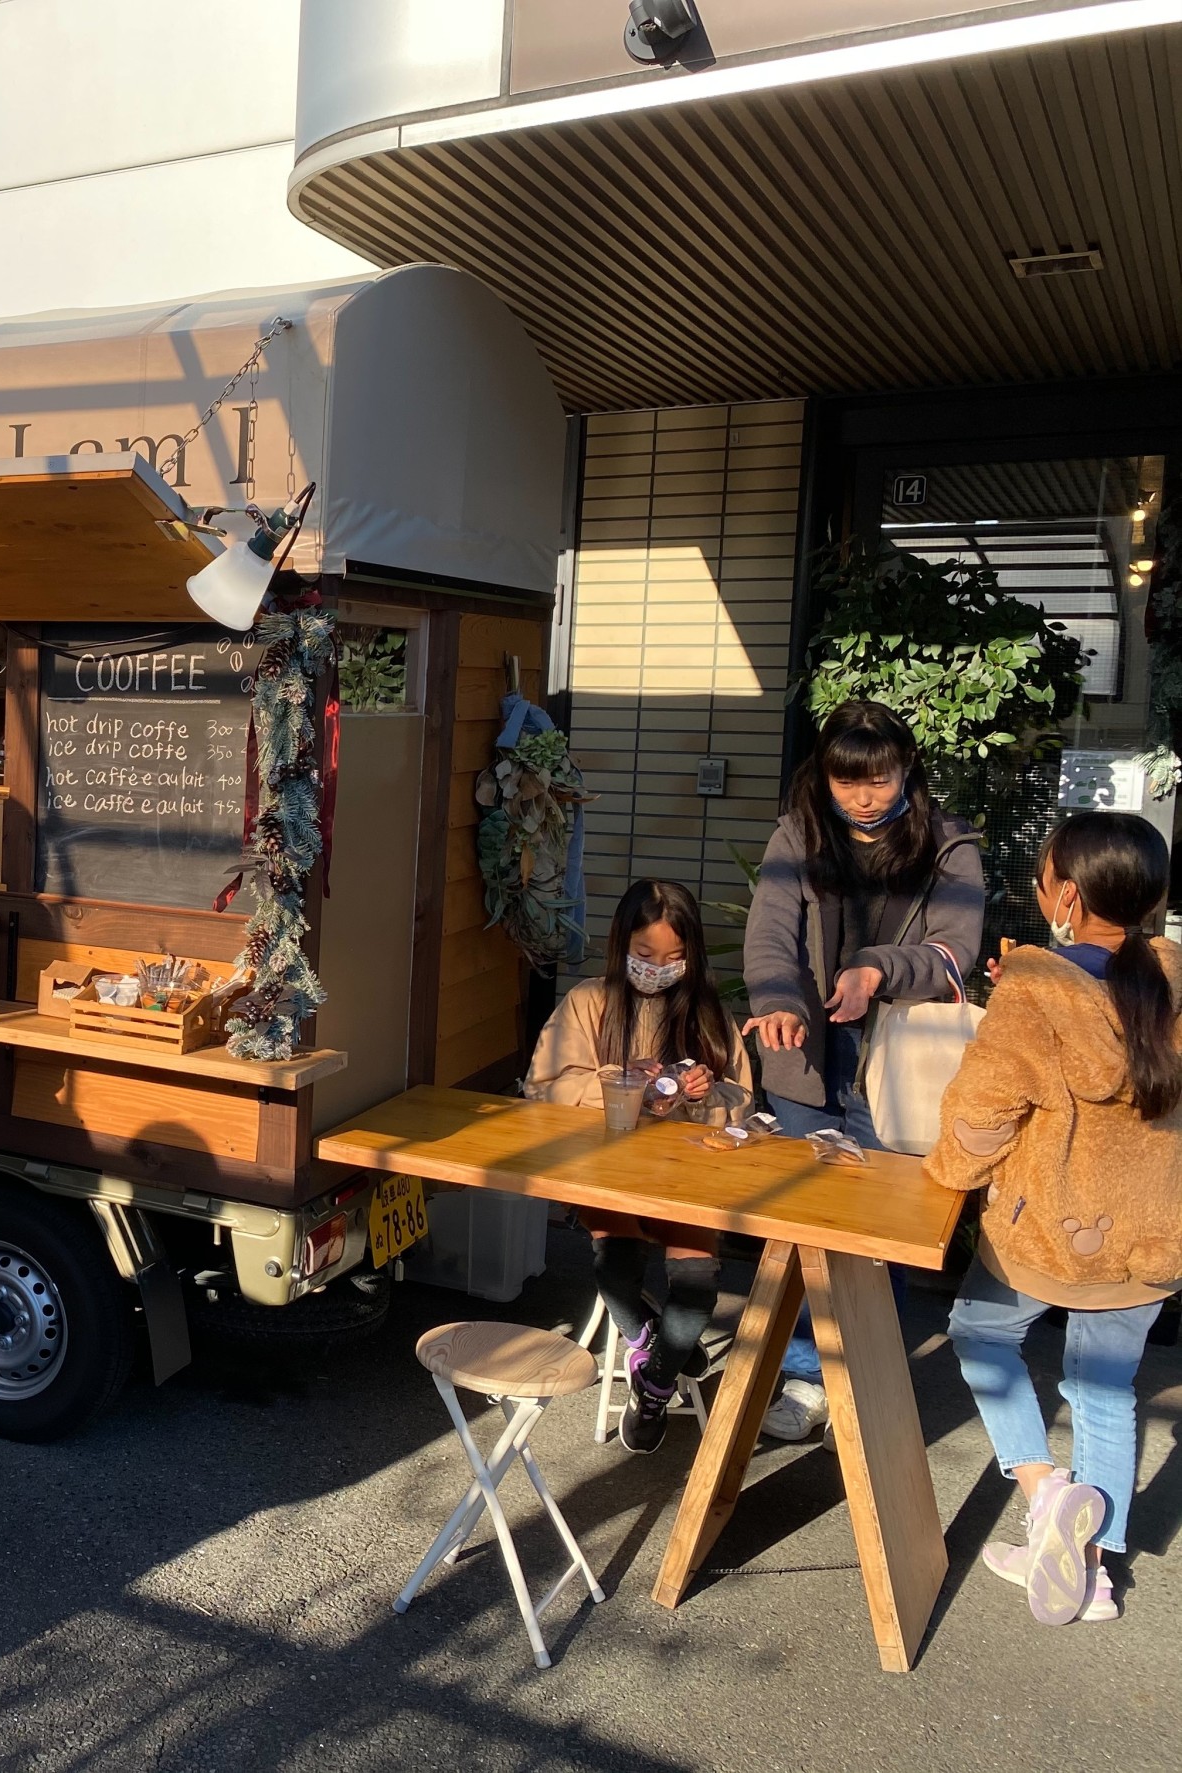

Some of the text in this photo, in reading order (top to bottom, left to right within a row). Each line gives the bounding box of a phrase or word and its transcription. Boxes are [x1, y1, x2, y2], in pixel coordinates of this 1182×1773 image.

[898, 479, 921, 503] 14
[75, 653, 207, 692] COOFFEE
[46, 712, 78, 733] hot
[86, 712, 123, 738] drip
[130, 720, 189, 741] coffe
[207, 720, 233, 738] 300
[48, 737, 76, 756] ice
[85, 738, 121, 758] drip
[129, 742, 187, 761] coffe
[207, 744, 233, 760] 350
[46, 766, 78, 787] hot
[217, 774, 242, 791] 400
[47, 791, 77, 810] ice
[214, 800, 241, 815] 450
[382, 1194, 424, 1254] 78-86
